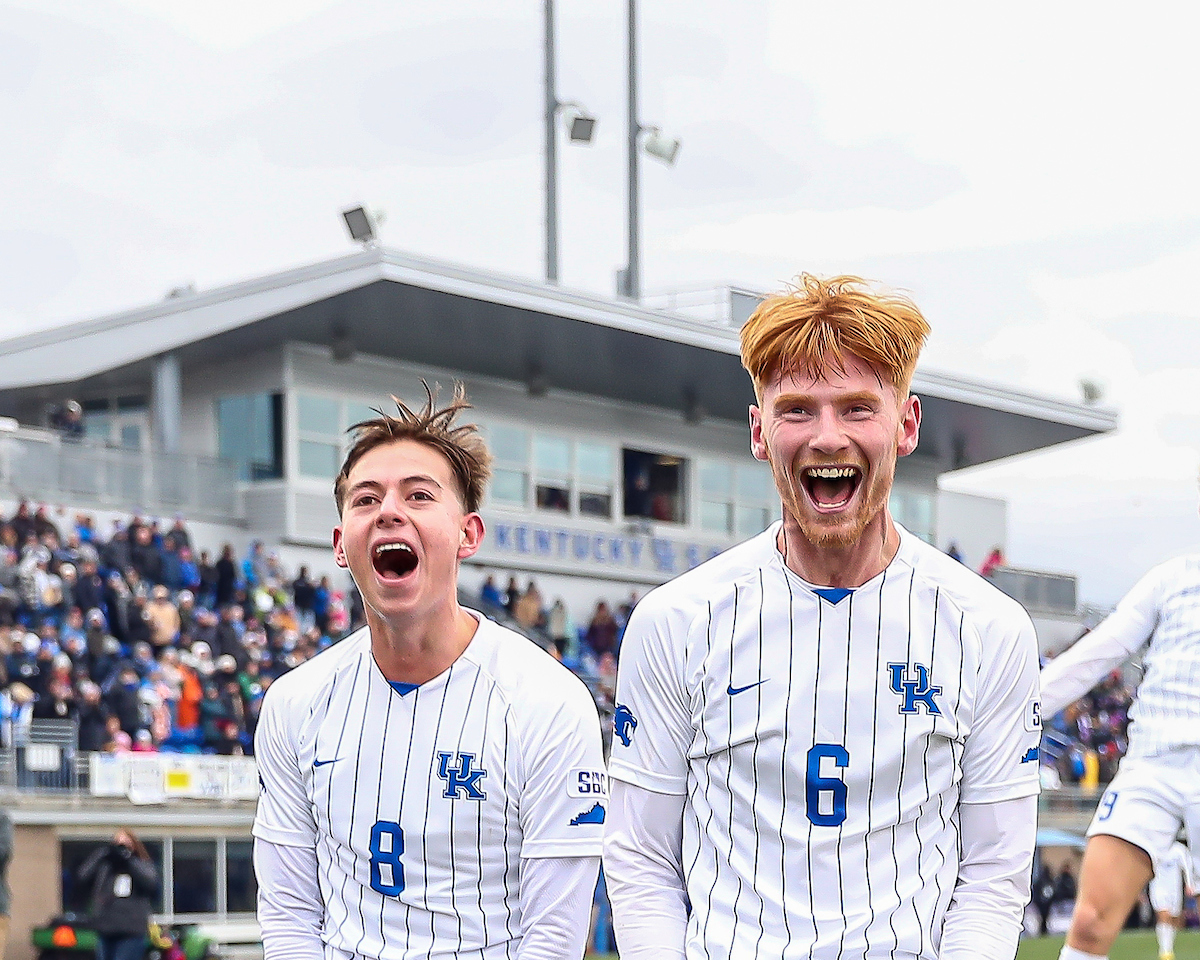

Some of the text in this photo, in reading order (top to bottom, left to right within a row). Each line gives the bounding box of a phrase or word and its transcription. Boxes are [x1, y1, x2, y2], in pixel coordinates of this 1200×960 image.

[494, 524, 644, 566] KENTUCKY
[887, 661, 944, 717] UK
[436, 750, 488, 800] UK
[806, 743, 850, 827] 6
[368, 819, 406, 898] 8
